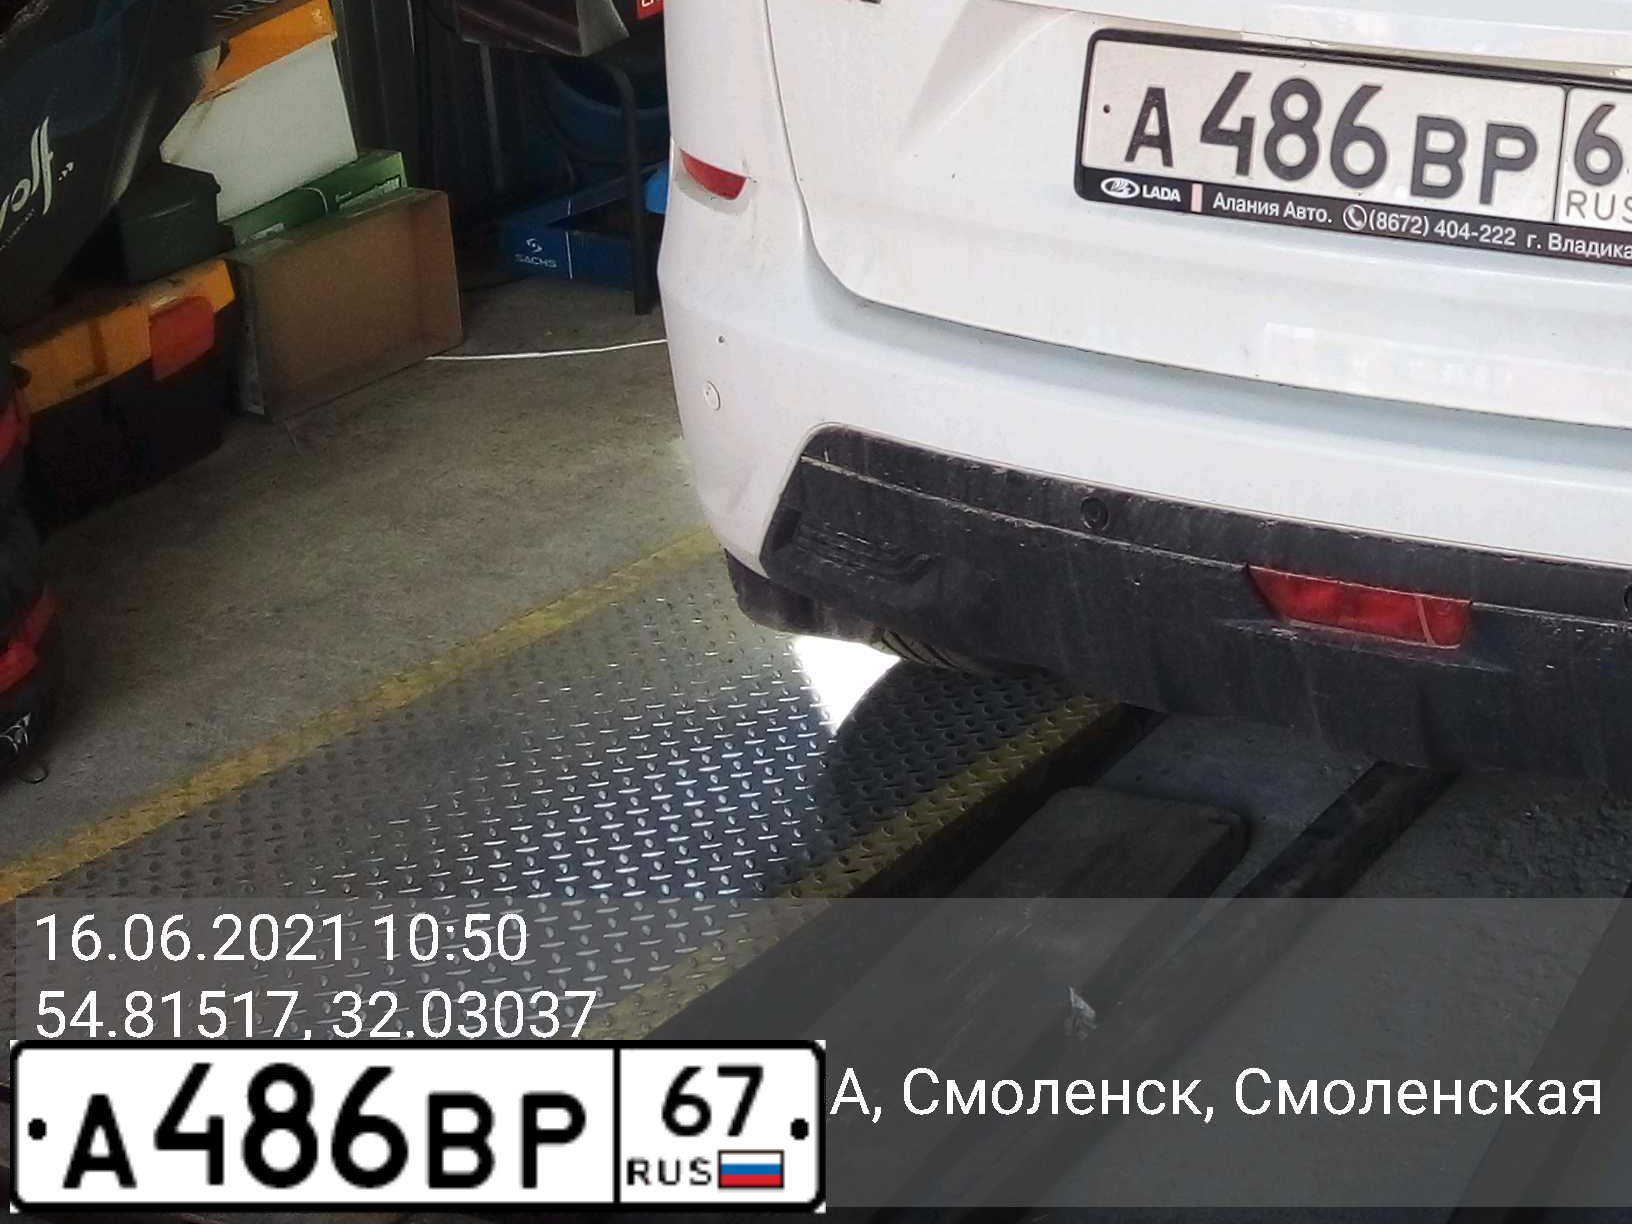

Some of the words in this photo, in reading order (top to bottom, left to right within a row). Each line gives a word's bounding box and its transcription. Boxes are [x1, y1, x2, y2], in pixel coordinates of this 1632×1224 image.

[1141, 183, 1181, 203] LADA
[1213, 192, 1280, 217] Алания
[1283, 200, 1334, 224] Авто.
[1369, 208, 1430, 237] (8672)
[1433, 219, 1517, 247] 404-222
[1526, 233, 1542, 250] г.
